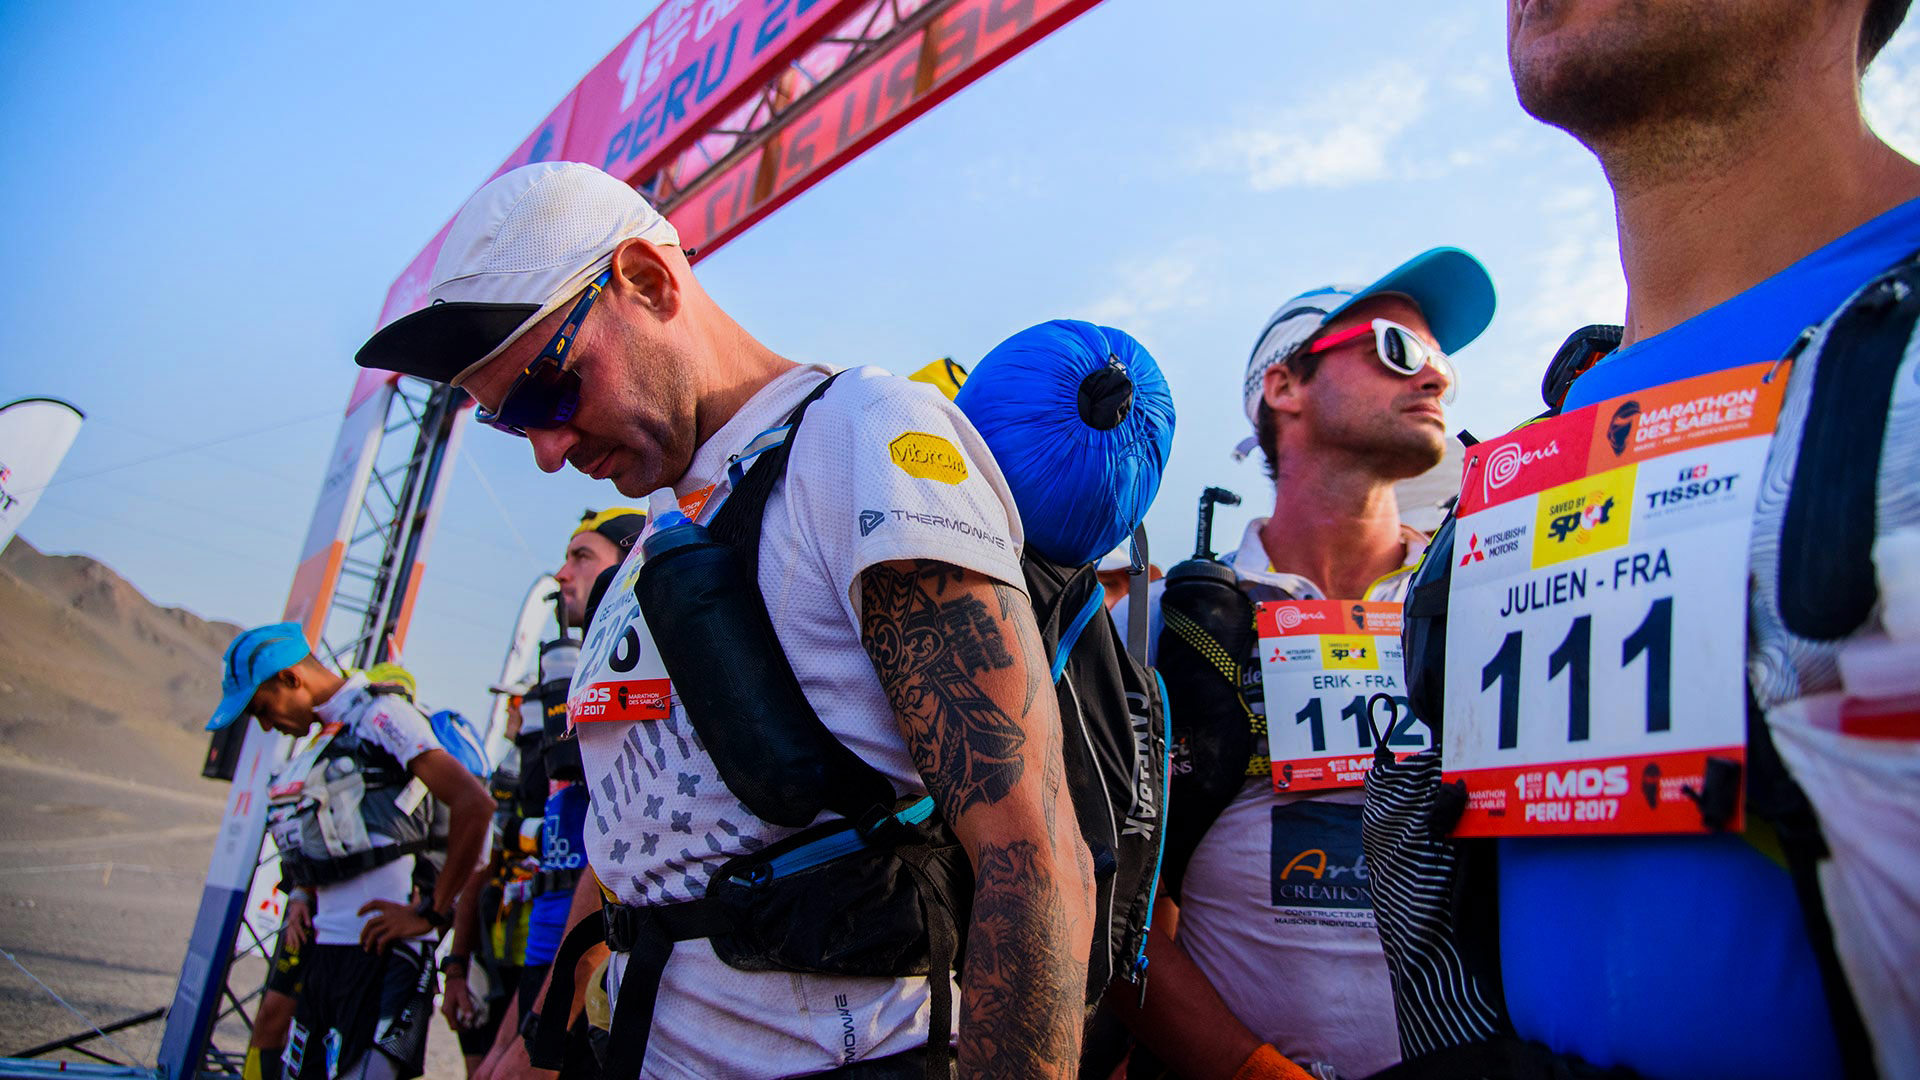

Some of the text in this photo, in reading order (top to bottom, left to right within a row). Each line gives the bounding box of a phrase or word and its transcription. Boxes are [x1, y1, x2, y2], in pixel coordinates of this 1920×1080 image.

[603, 20, 741, 172] PERU
[1639, 387, 1757, 428] MARATHON
[1635, 404, 1753, 444] DES SABLES
[1484, 440, 1559, 504] Perú
[1646, 473, 1740, 509] TISSOT
[1549, 496, 1587, 516] SAVED BY
[890, 509, 1006, 550] THERMOWAVE
[1483, 525, 1527, 548] MITSUBISHI
[1488, 540, 1519, 558] MOTORS
[1500, 567, 1587, 618] JULIEN
[1613, 547, 1672, 591] FRA
[1312, 674, 1351, 690] ERIK
[1365, 674, 1397, 689] FRA
[1480, 595, 1674, 751] 111
[583, 704, 607, 716] 2017
[628, 692, 660, 700] MARATHON
[1295, 695, 1425, 752] 112
[1337, 771, 1365, 782] PERU
[1545, 765, 1629, 799] MDS
[1479, 799, 1506, 810] SABLES
[1524, 798, 1619, 823] PERU 2017
[1274, 917, 1318, 926] MAISONS
[1284, 909, 1365, 919] CONSTRUCTEUR
[834, 993, 856, 1063] MOWAVE
